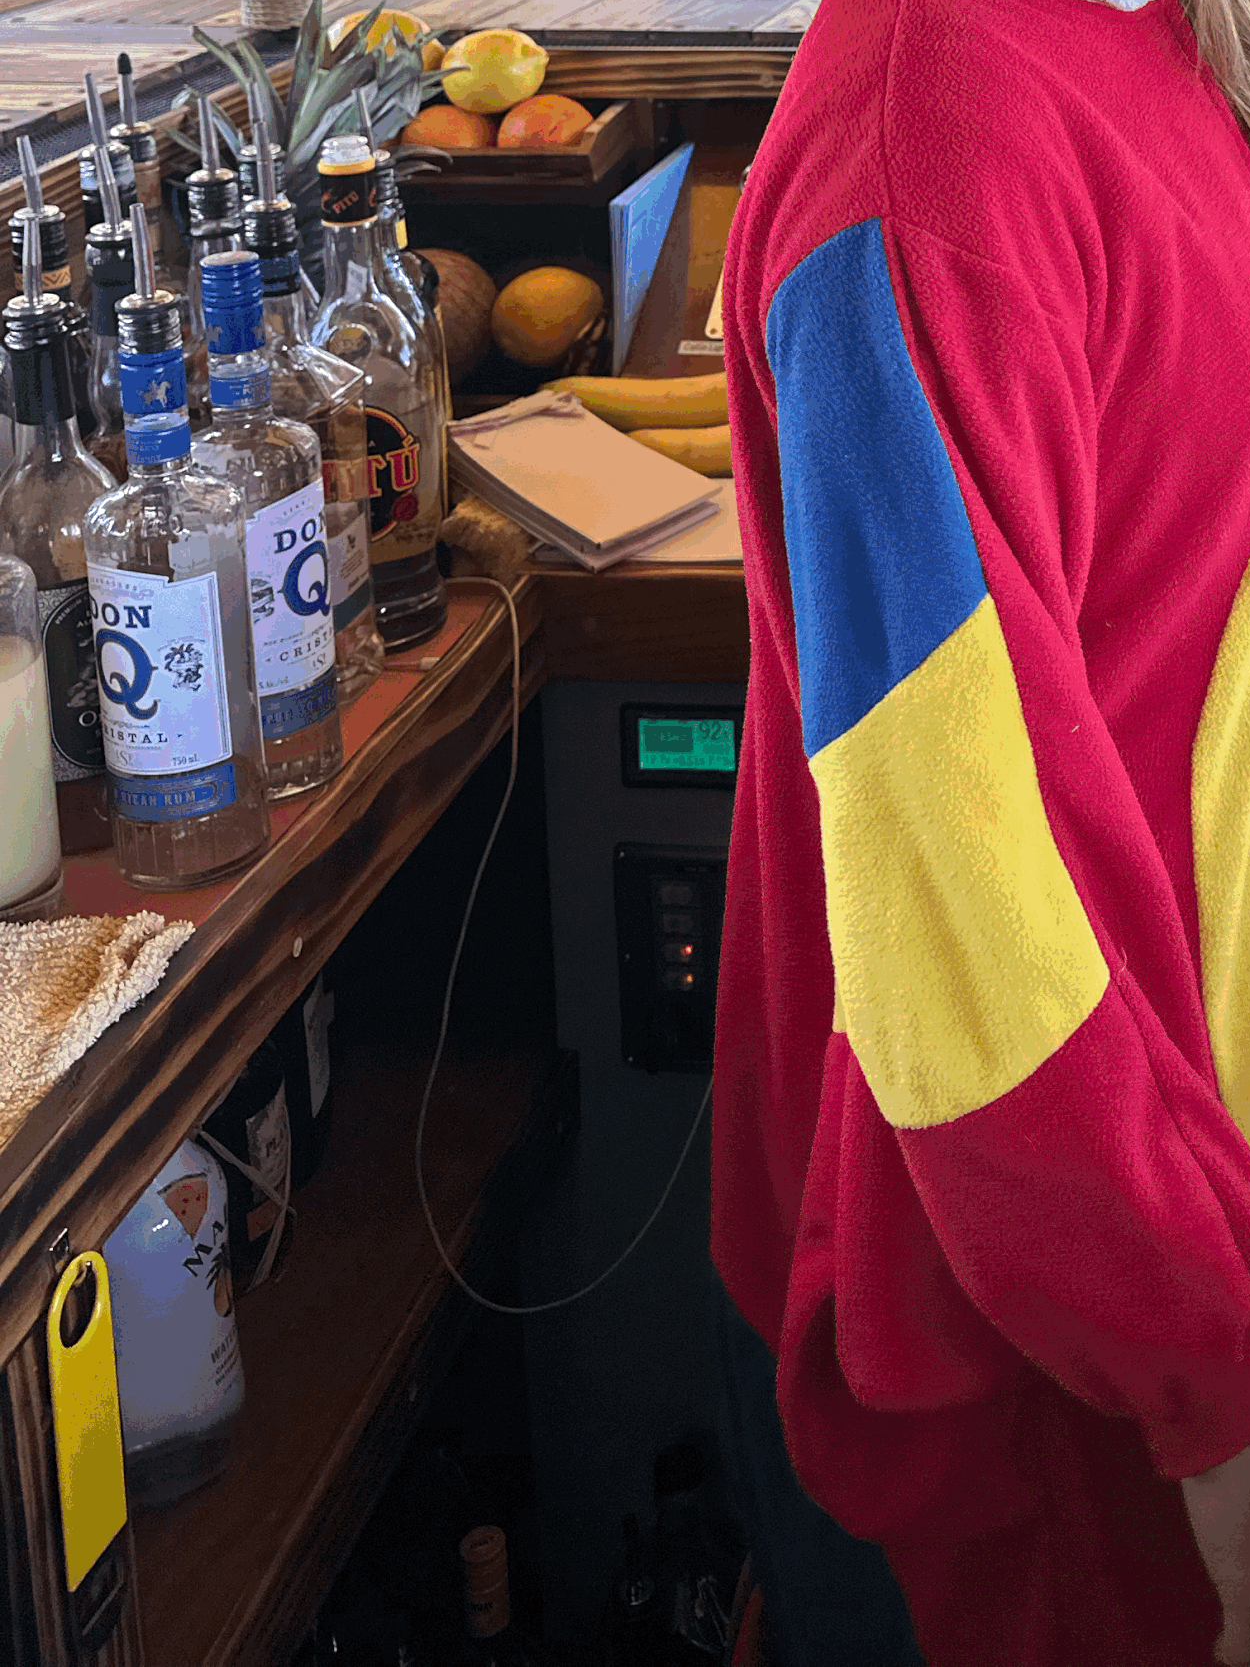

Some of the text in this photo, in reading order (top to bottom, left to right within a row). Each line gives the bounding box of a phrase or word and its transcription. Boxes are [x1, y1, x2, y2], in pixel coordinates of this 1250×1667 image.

[278, 540, 330, 616] Q
[96, 628, 161, 720] Q
[103, 722, 168, 744] RISTAL
